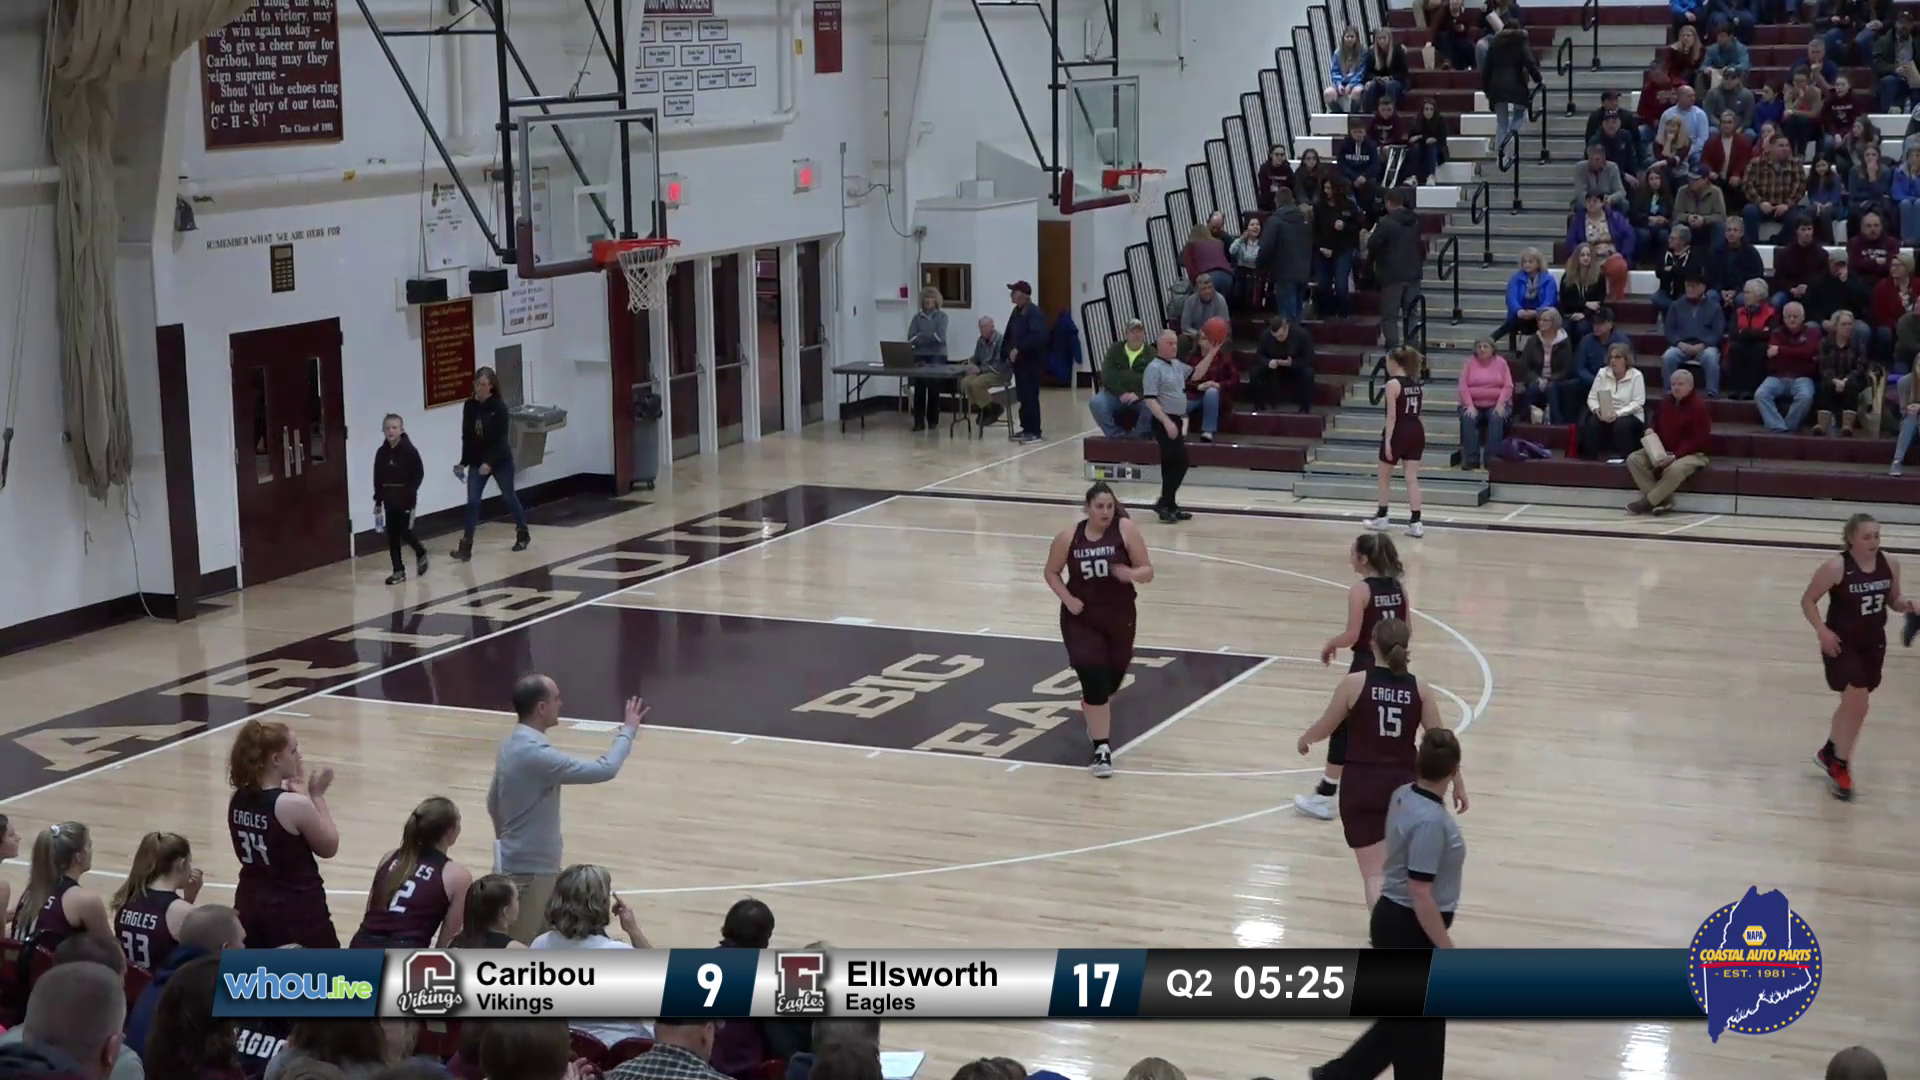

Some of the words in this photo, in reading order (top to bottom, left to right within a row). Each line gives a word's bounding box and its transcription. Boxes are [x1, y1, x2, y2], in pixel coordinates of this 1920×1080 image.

[261, 10, 271, 21] to
[274, 9, 309, 22] victory,
[313, 11, 332, 24] may
[232, 24, 250, 37] win
[255, 24, 282, 39] again
[285, 24, 311, 38] today
[220, 40, 232, 53] So
[236, 40, 256, 55] give
[260, 43, 266, 52] a
[269, 40, 295, 52] cheer
[298, 41, 317, 51] now
[321, 38, 335, 50] for
[206, 53, 251, 68] Caribou,
[255, 53, 277, 68] long
[282, 55, 302, 66] may
[307, 52, 328, 66] they
[208, 70, 231, 85] reign
[236, 69, 276, 84] supreme
[220, 83, 248, 97] Shout
[269, 83, 284, 95] the
[287, 82, 317, 95] echoes
[320, 81, 338, 96] ring
[210, 101, 225, 114] for
[229, 100, 245, 113] the
[249, 98, 274, 115] glory
[278, 97, 289, 111] of
[292, 100, 309, 110] our
[312, 97, 338, 110] team,
[280, 124, 292, 134] The
[294, 124, 311, 133] Class
[312, 123, 319, 132] of
[250, 234, 272, 245] WHAT
[275, 232, 289, 243] WE
[291, 230, 304, 241] ARE
[306, 228, 324, 239] HERE
[327, 226, 341, 237] FOR
[1405, 396, 1418, 414] 14
[1073, 545, 1116, 559] ELLSWORTH
[1080, 559, 1109, 580] 50
[1374, 593, 1402, 608] EAGLES
[1861, 594, 1885, 616] 23
[791, 653, 985, 718] BIG
[1371, 686, 1411, 704] EAGLES
[1378, 705, 1402, 737] 15
[233, 809, 268, 830] EAGLES
[237, 830, 271, 866] 34
[388, 880, 416, 914] 2
[120, 908, 159, 930] EAGLES
[122, 931, 151, 969] 33
